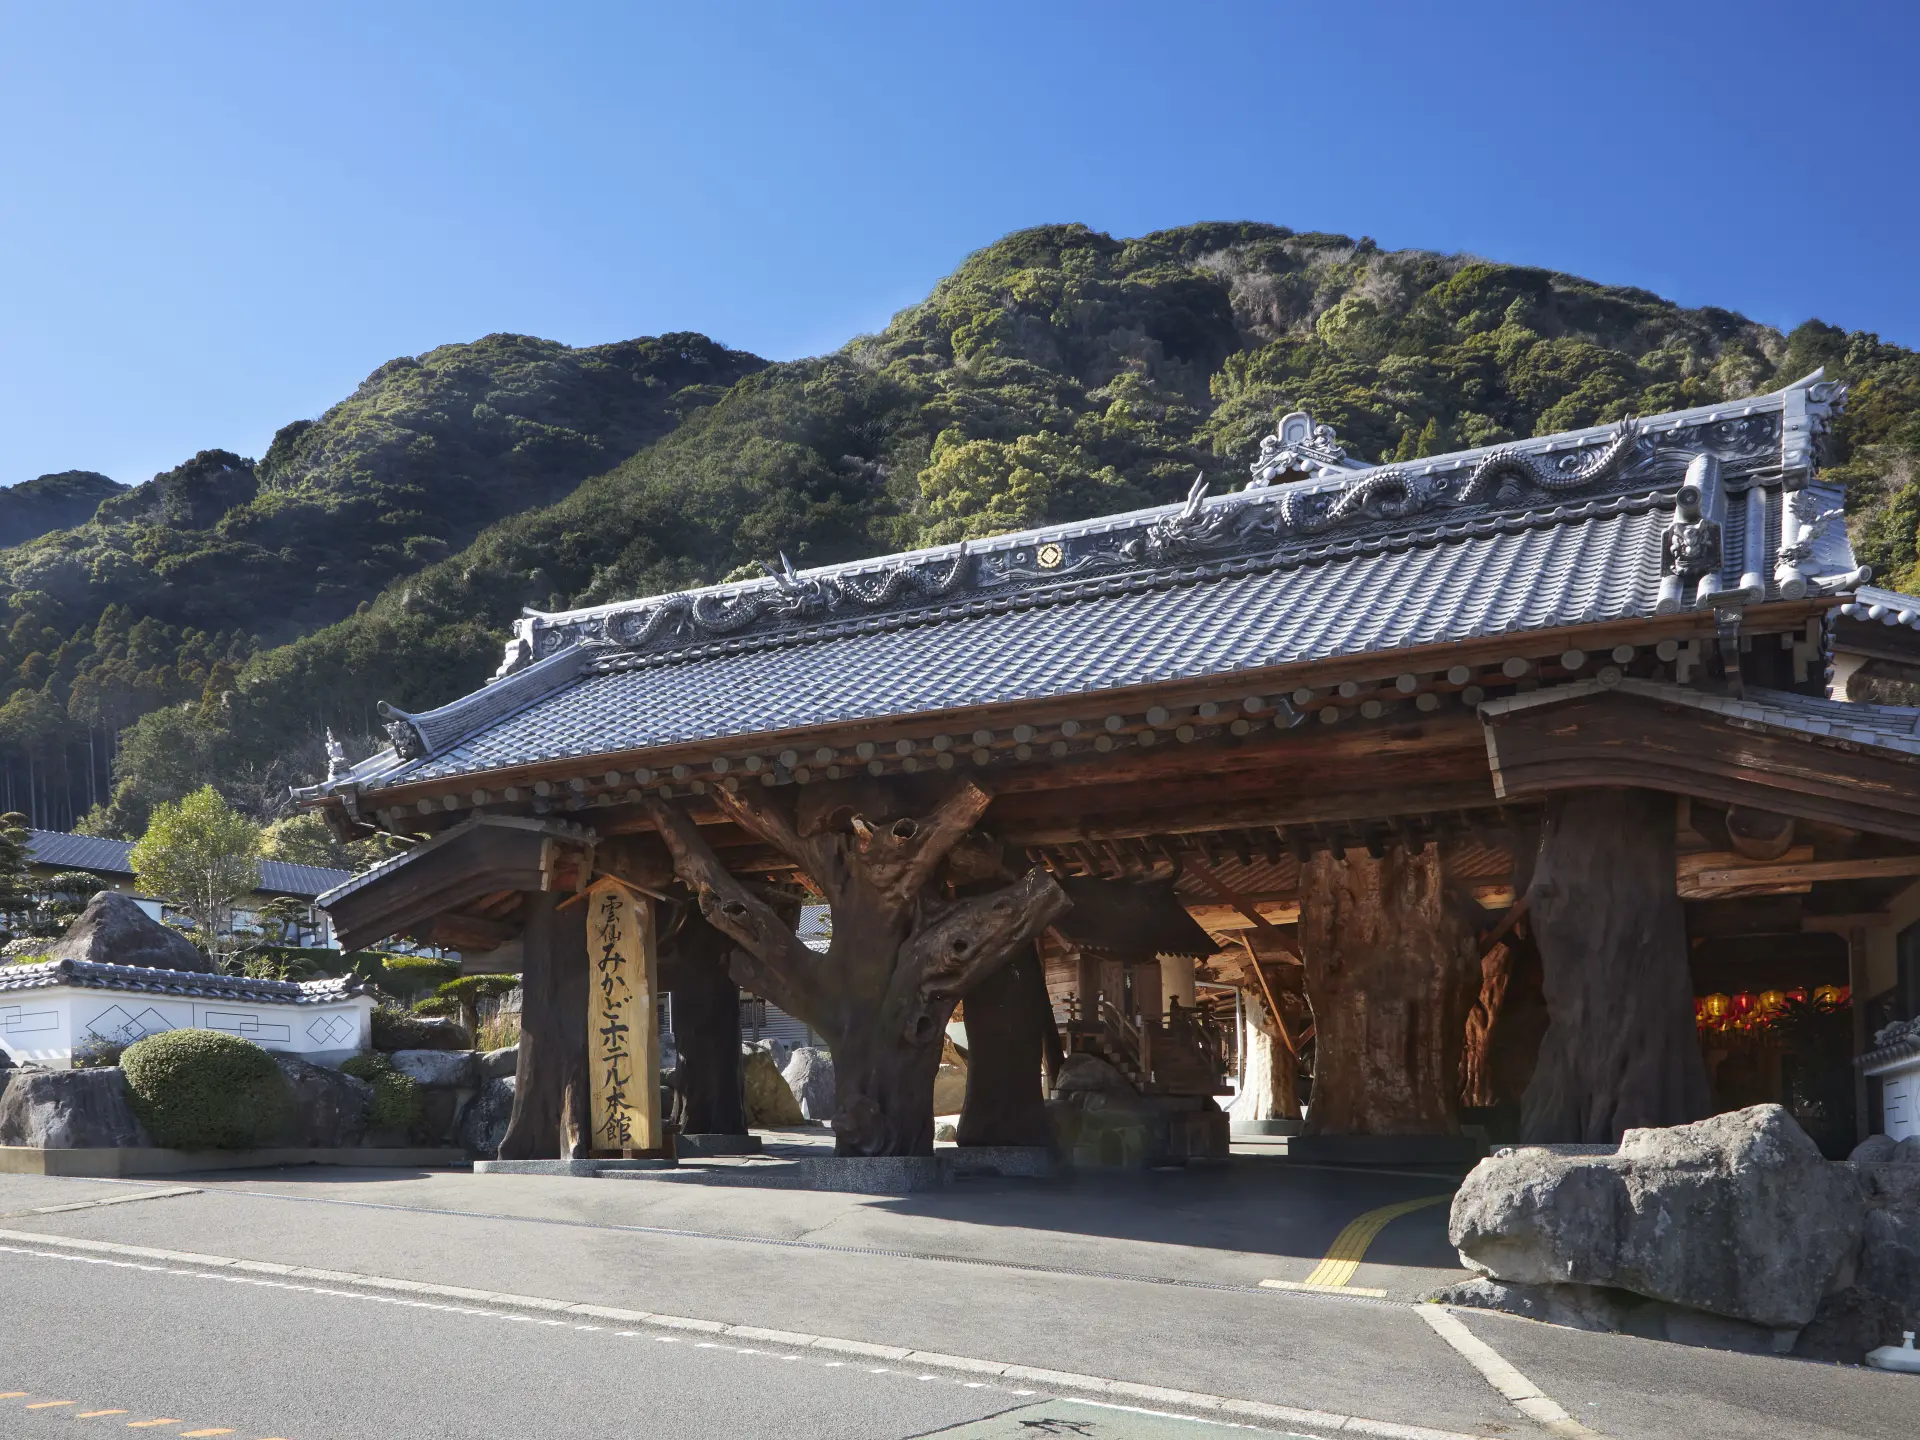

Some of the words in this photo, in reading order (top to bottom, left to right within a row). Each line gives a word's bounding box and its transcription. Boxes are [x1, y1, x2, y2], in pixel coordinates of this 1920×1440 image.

[596, 896, 635, 1146] 雲仙みかどホテル本館
